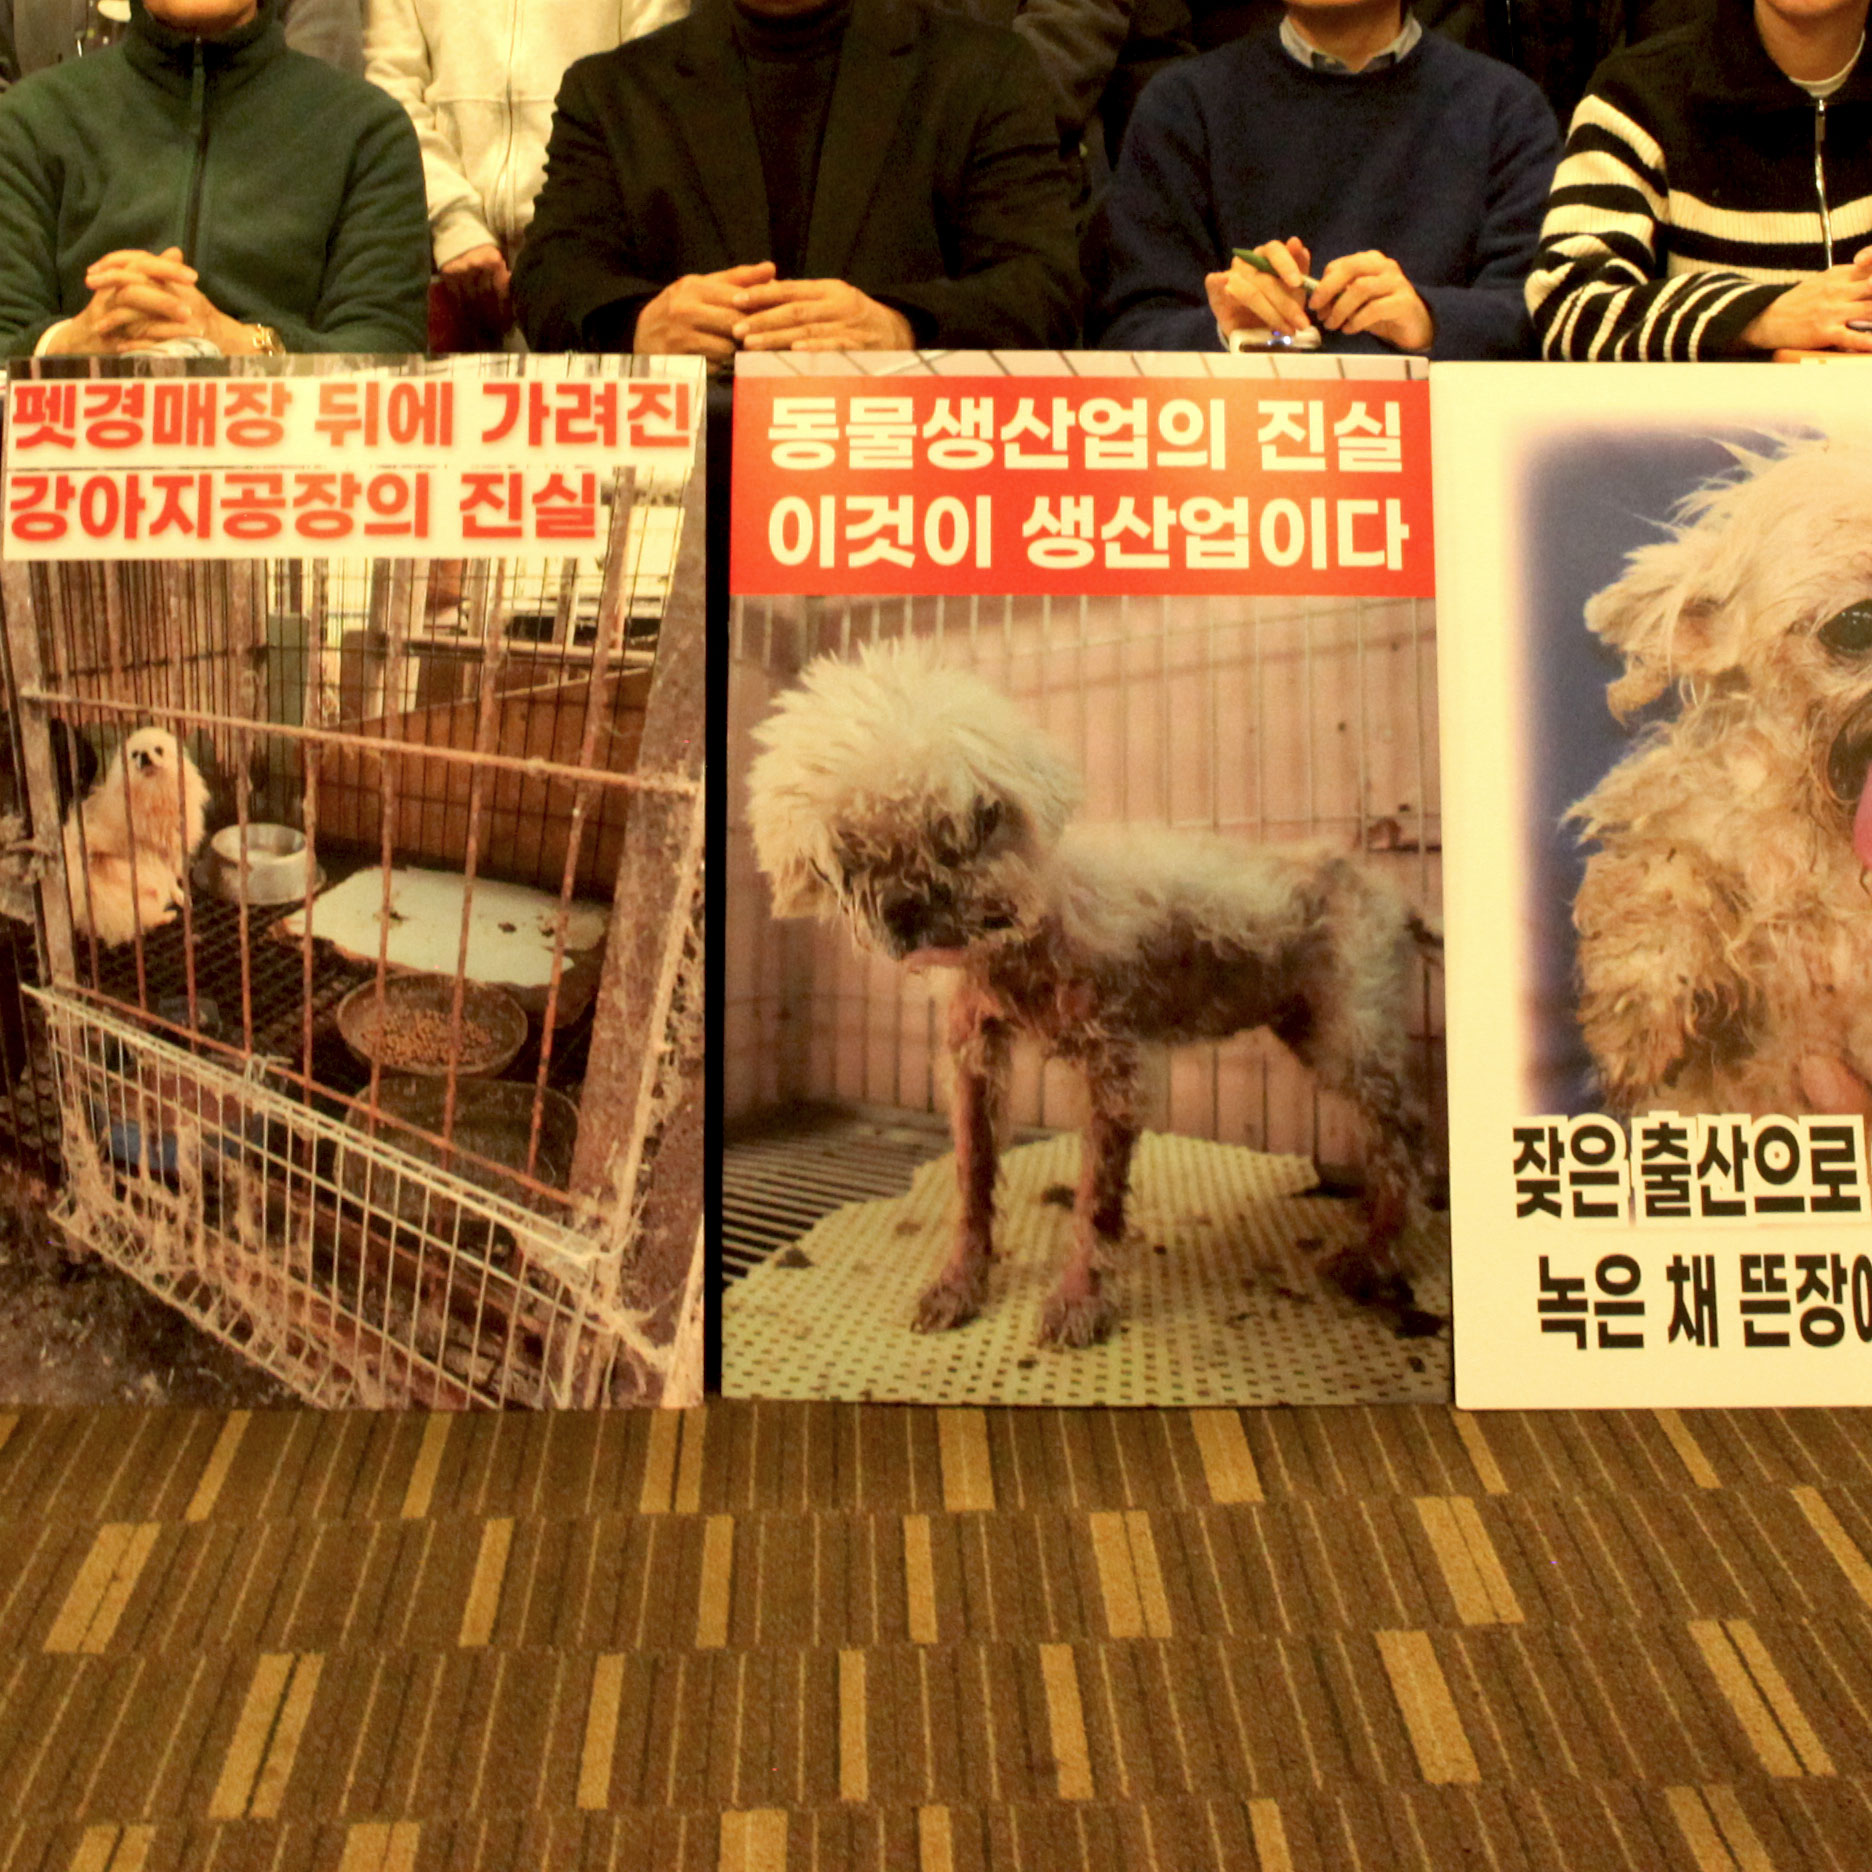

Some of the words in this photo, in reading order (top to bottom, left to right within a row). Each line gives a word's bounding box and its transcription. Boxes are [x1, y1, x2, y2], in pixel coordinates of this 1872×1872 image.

[12, 382, 292, 449] 펫경매장
[315, 382, 454, 447] 뒤에
[482, 382, 691, 448] 가려진
[768, 397, 1227, 470] 동물생산업의
[1258, 400, 1403, 472] 진실
[9, 473, 429, 541] 강아지공장의
[460, 472, 597, 539] 진실
[768, 494, 992, 568] 이것이
[1022, 496, 1410, 570] 생산업이다
[1513, 1124, 1619, 1219] 잦은
[1641, 1122, 1862, 1218] 출산으로
[1537, 1253, 1645, 1350] 녹은
[1666, 1253, 1719, 1349] 채
